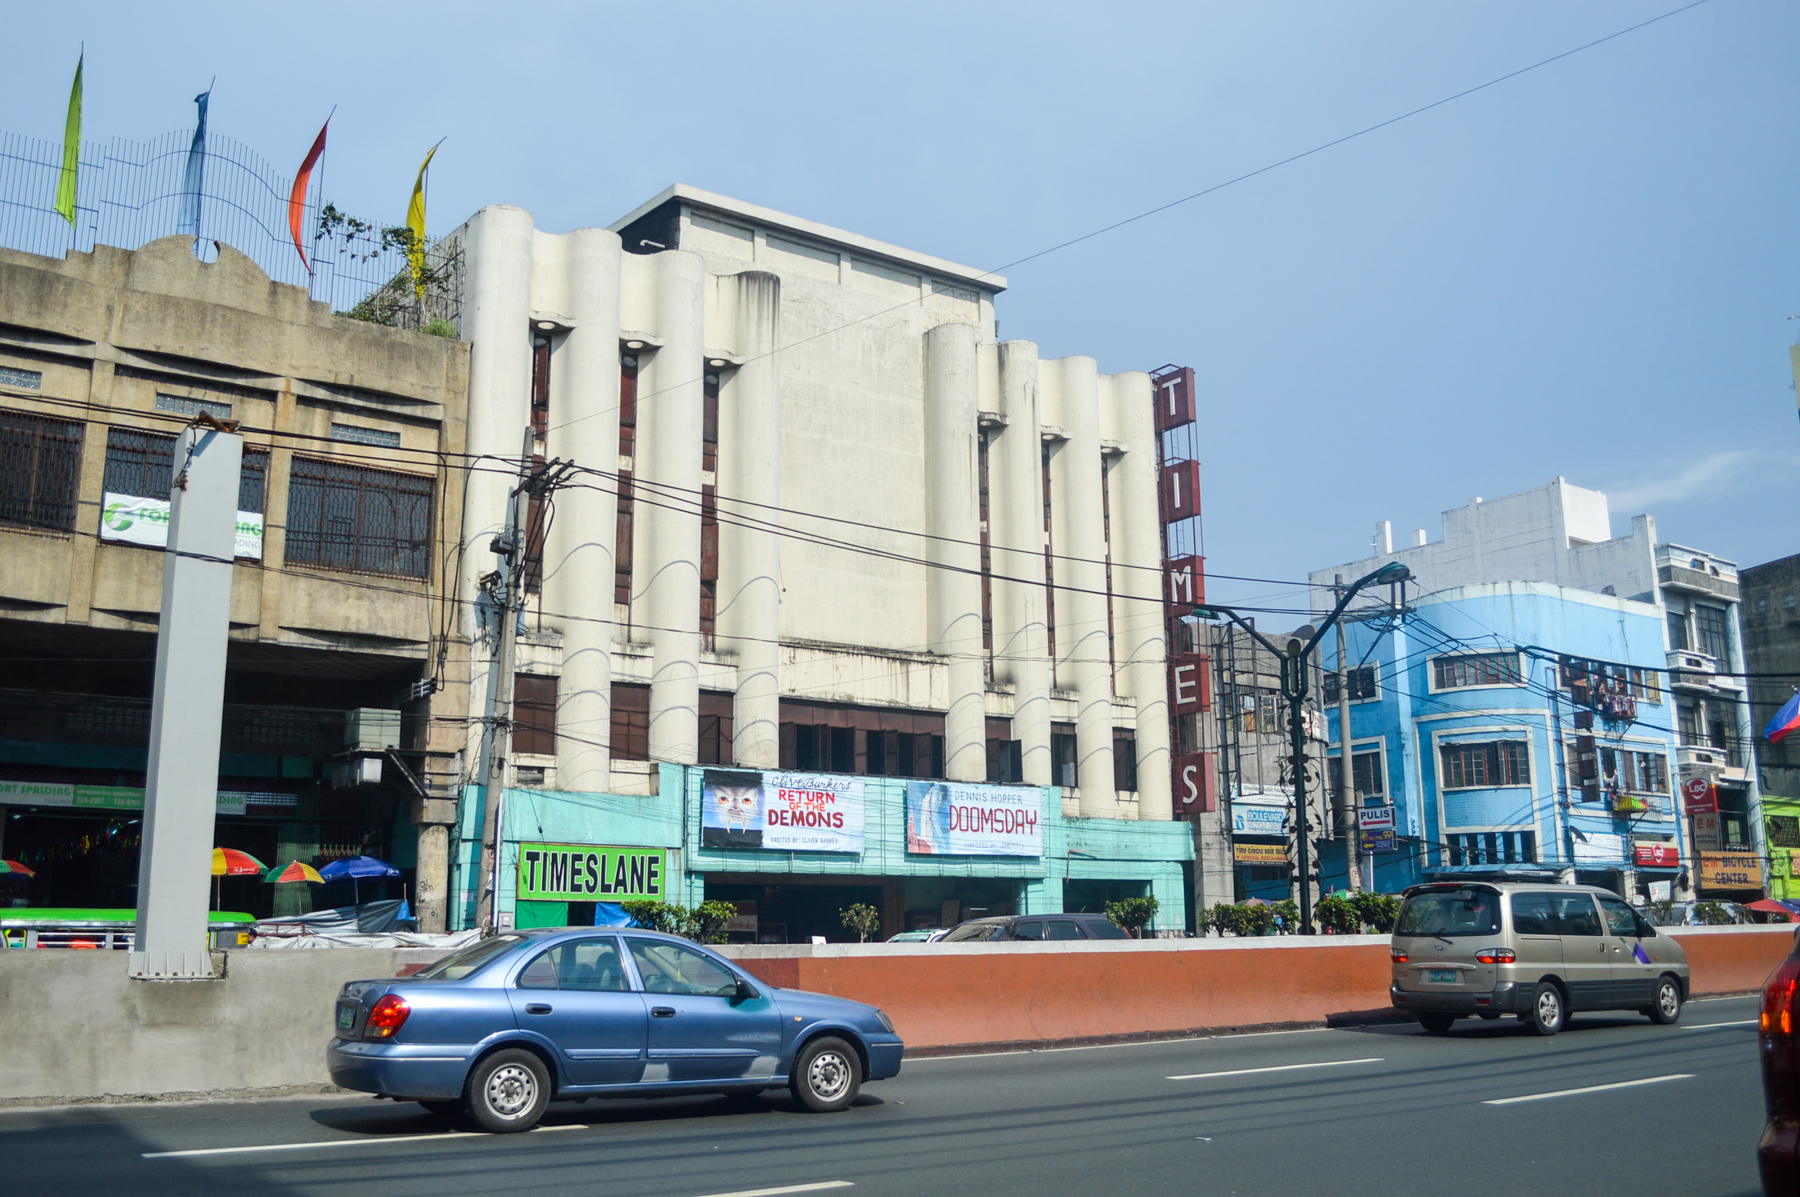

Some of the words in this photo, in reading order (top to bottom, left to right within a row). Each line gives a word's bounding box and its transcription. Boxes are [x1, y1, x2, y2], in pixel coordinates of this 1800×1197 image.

[139, 508, 170, 523] FO
[234, 538, 261, 549] ADING
[21, 785, 71, 796] SPALDING
[1689, 784, 1707, 793] LBC
[778, 789, 835, 804] RETURN
[954, 790, 988, 802] DENNIS
[991, 793, 1023, 804] HOPPER
[789, 801, 801, 811] OF
[804, 802, 826, 812] THE
[768, 809, 844, 828] DEMONS
[949, 804, 1037, 835] DOOMSDAY
[1247, 811, 1283, 822] BOULEVARD
[1360, 809, 1390, 820] PULIS
[1723, 856, 1757, 868] BICYCLE
[525, 851, 660, 895] TIMESLANE
[1715, 872, 1749, 884] CENTER
